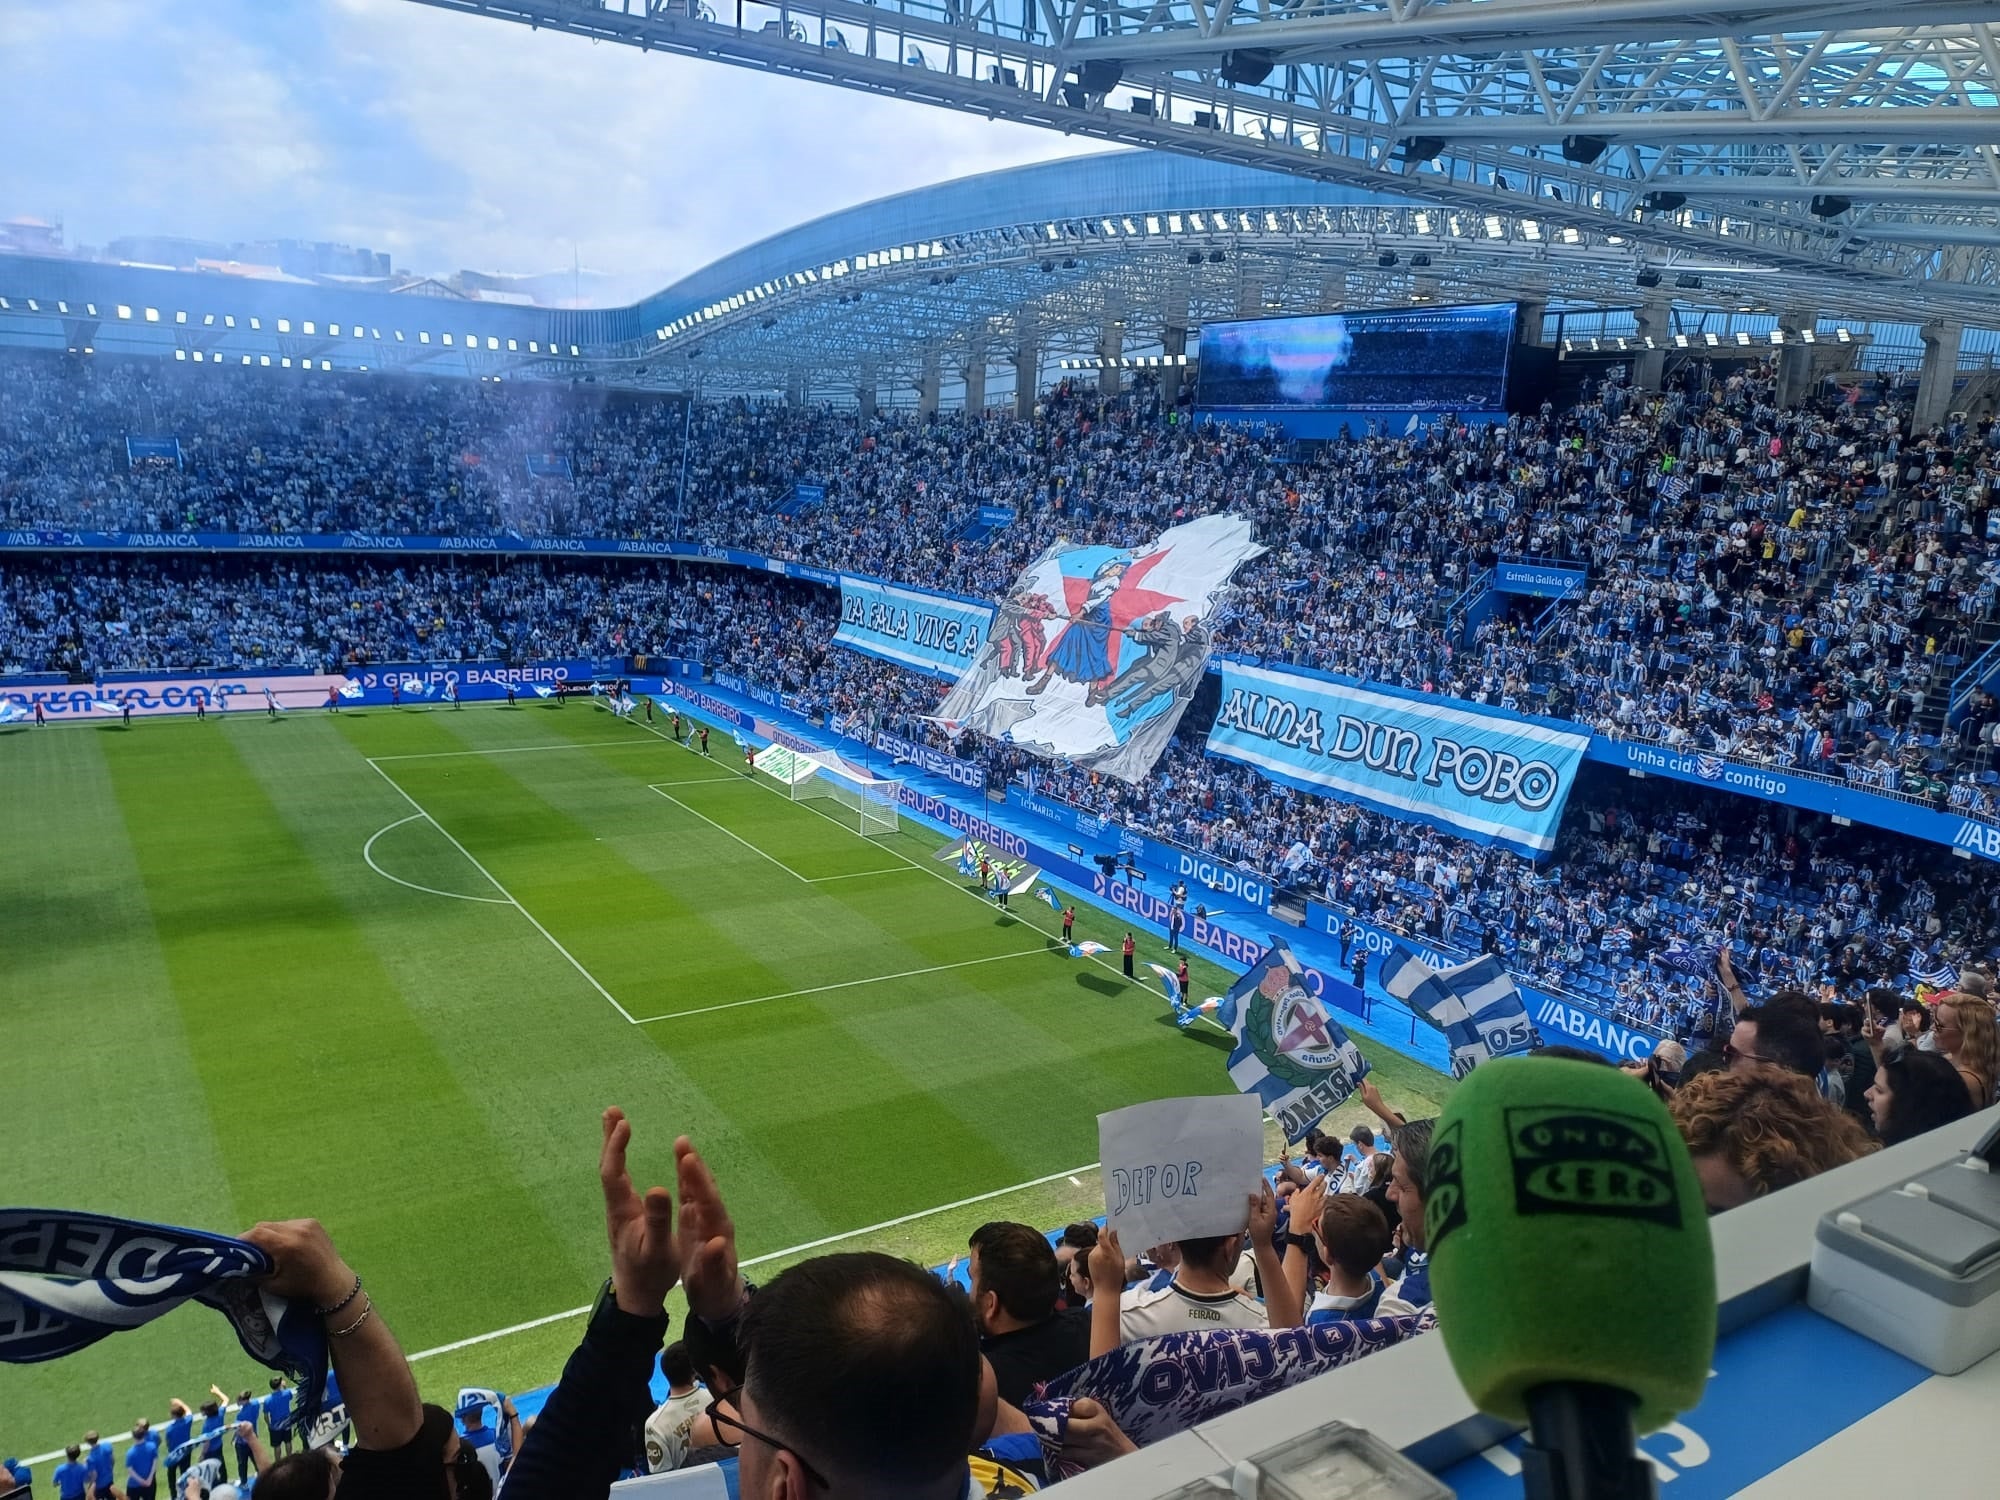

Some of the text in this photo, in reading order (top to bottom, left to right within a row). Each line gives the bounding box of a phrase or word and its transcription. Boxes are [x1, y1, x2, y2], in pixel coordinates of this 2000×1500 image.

[1506, 571, 1562, 586] Estrella Galicia
[866, 602, 909, 641] FALA
[913, 611, 960, 652] VIVE
[383, 667, 569, 687] GRUPO BARREIRO
[674, 682, 741, 726] GRUPO BARREIRO
[1218, 688, 1558, 812] ALMA DUN POBO
[1627, 746, 1665, 772] Unha
[1725, 771, 1787, 796] contigo
[899, 789, 945, 821] GRUPO
[950, 807, 1028, 859] BARREIRO
[1110, 881, 1186, 933] GRUPO
[1223, 870, 1264, 906] DIGI
[1532, 1126, 1644, 1153] ONDA
[1112, 1160, 1203, 1217] DEPOR
[1545, 1165, 1657, 1199] CERO
